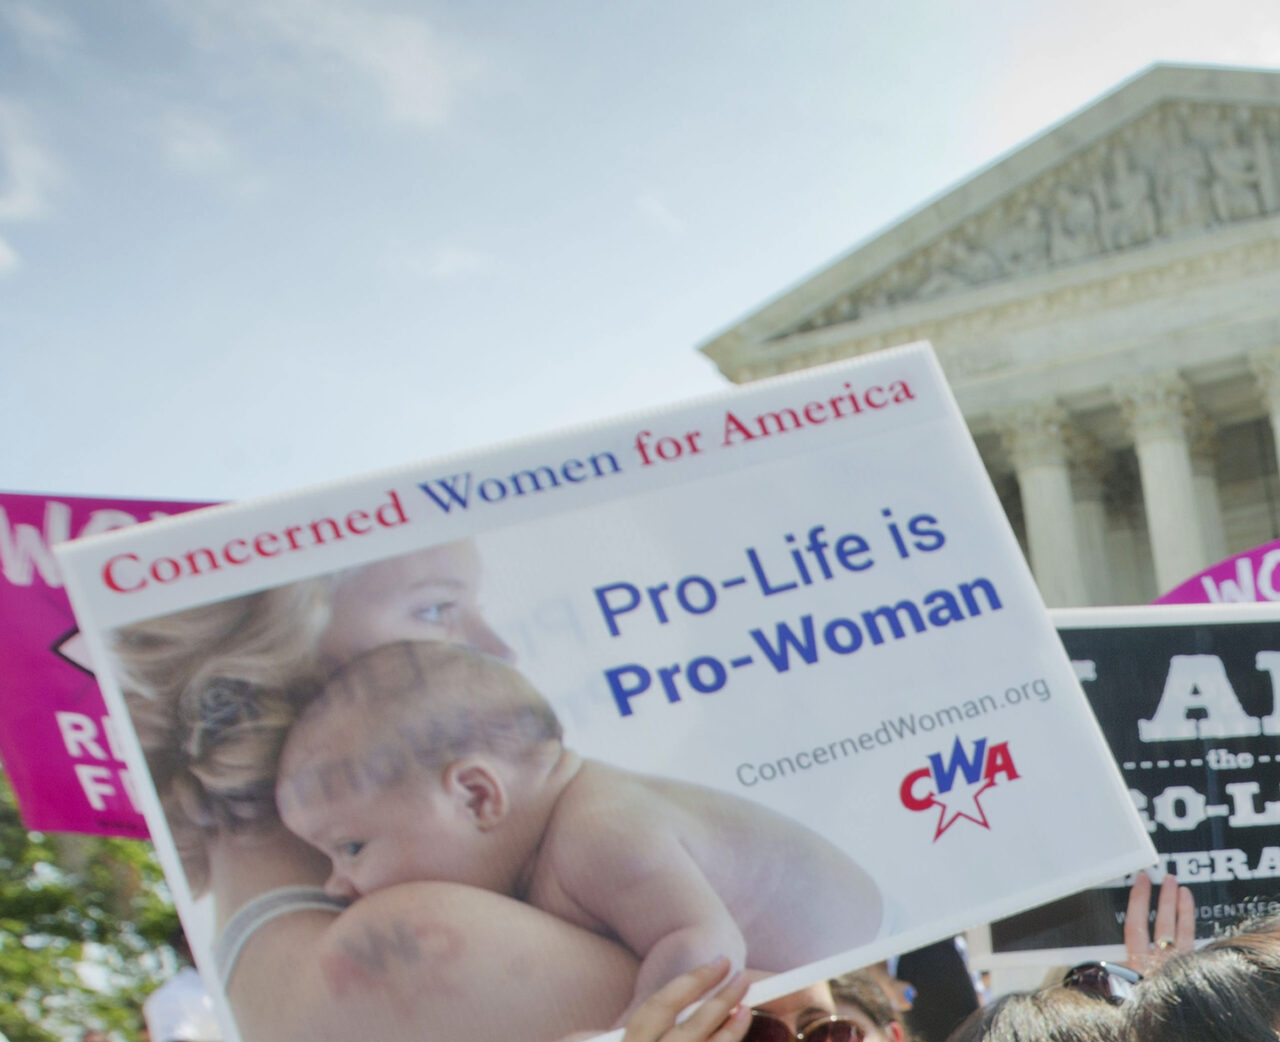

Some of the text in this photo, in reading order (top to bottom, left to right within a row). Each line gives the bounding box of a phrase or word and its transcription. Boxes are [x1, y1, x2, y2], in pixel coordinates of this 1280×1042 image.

[102, 491, 409, 594] Concerned
[420, 450, 622, 514] Women
[634, 431, 702, 467] for
[722, 380, 915, 447] America
[594, 508, 946, 637] Pro-Life is
[604, 576, 1003, 718] Pro-Woman
[736, 678, 1052, 788] ConcernedWoman.org
[900, 735, 1022, 812] CWA
[1207, 749, 1253, 770] the
